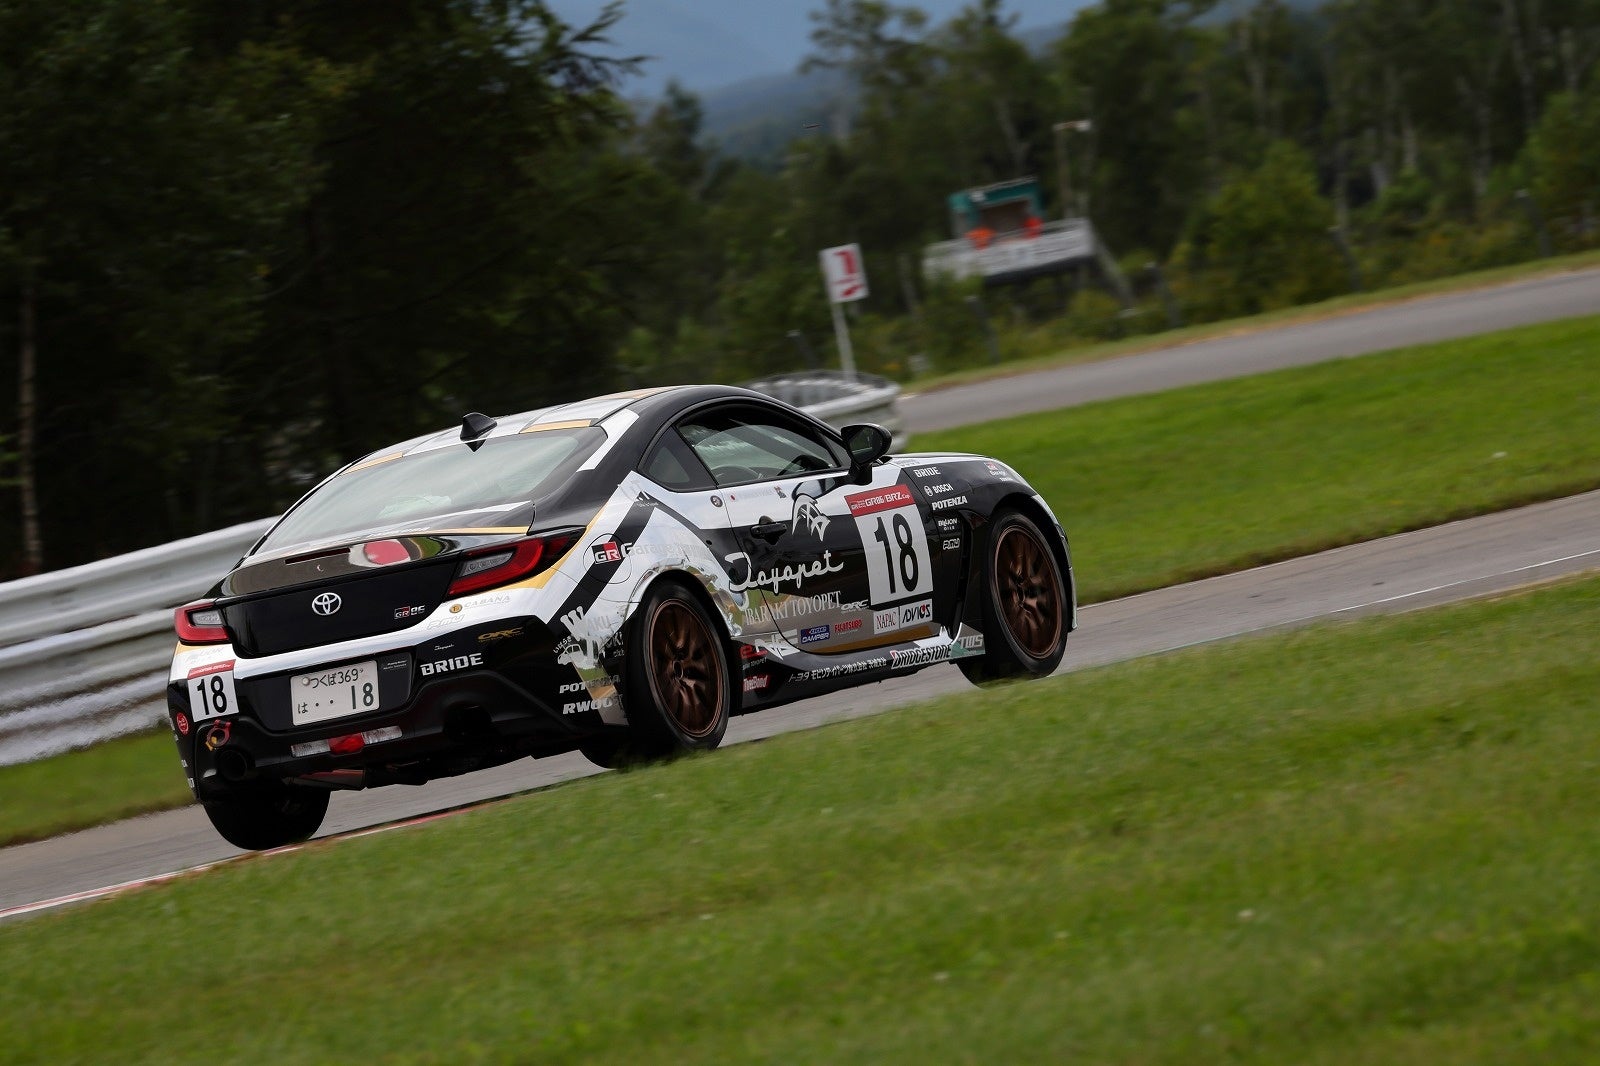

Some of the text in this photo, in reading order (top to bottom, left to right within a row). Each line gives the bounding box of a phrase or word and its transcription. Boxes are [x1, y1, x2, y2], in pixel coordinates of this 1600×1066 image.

[913, 467, 941, 478] BRIDE
[932, 483, 954, 494] BOSCH
[932, 495, 968, 511] POTENZA
[874, 513, 919, 594] 18
[744, 590, 841, 626] IBARAKI TOYOPET
[840, 599, 869, 611] ORC
[876, 611, 897, 630] NAPAC
[958, 634, 984, 649] TWS
[419, 652, 484, 677] BRIDE
[890, 643, 952, 669] BRIDGESTONE
[789, 673, 810, 683] トヨタ
[196, 675, 228, 716] 18
[297, 702, 309, 714] は
[351, 682, 374, 710] 18
